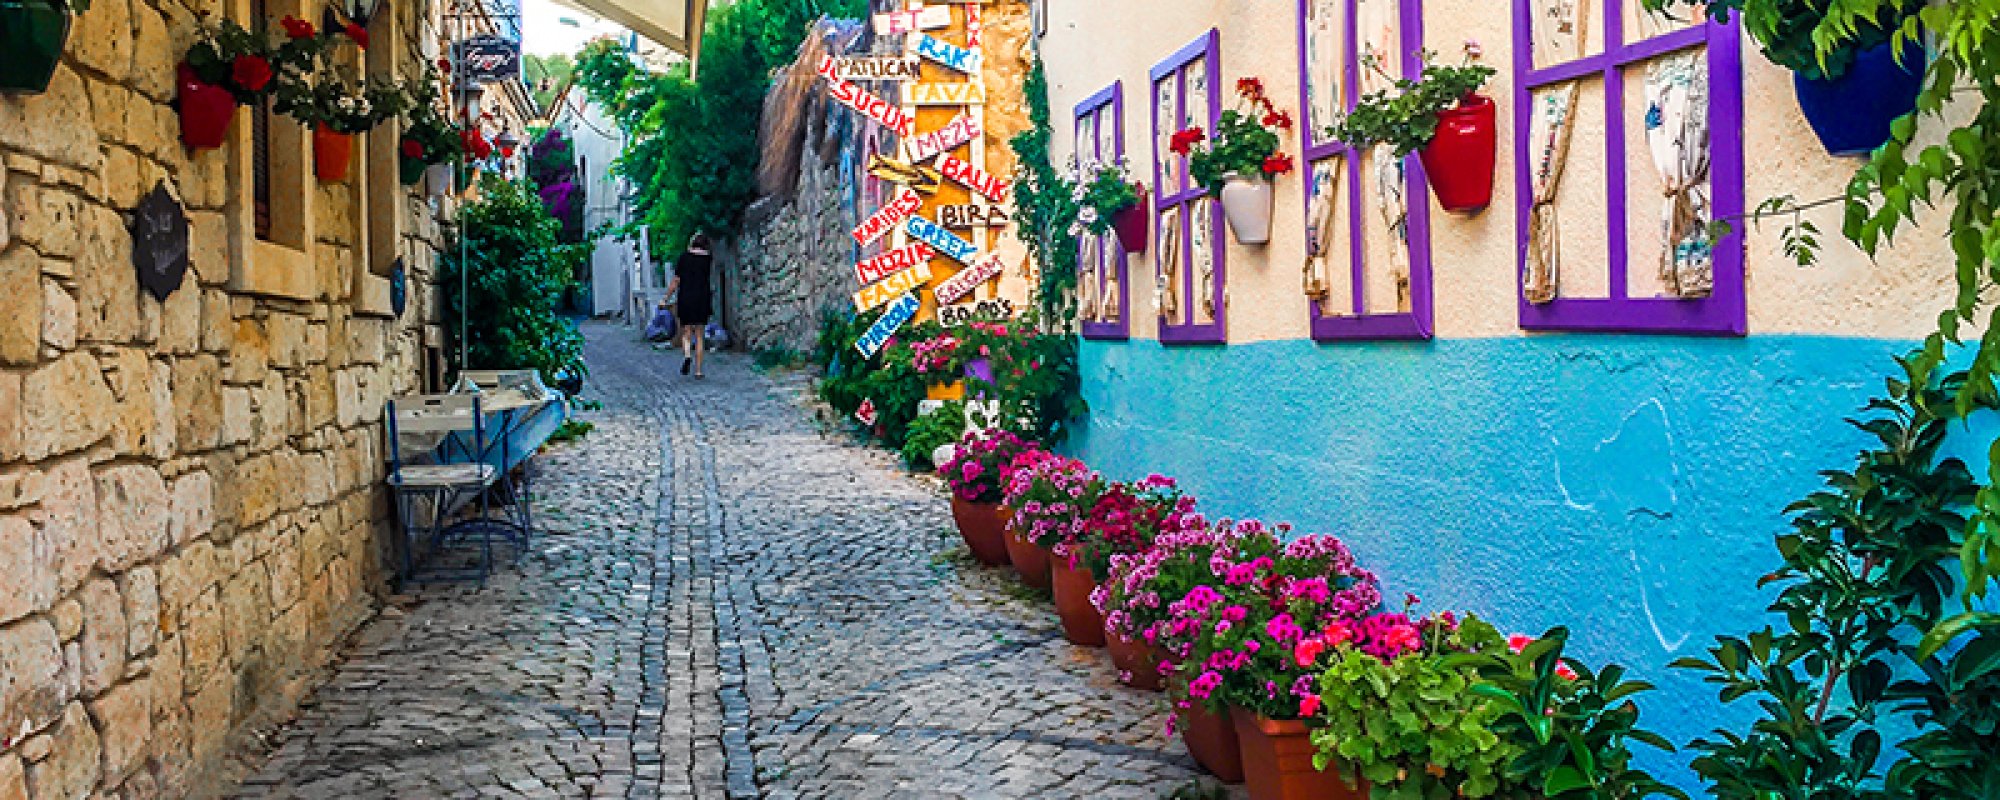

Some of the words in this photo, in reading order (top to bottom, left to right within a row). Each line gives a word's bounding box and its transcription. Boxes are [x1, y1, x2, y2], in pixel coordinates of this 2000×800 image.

[890, 9, 923, 34] ET
[837, 58, 920, 76] PATLICAN
[911, 83, 982, 101] FAVA
[832, 81, 913, 138] SUCUK
[917, 115, 980, 155] MEZE
[942, 156, 1007, 201] BALIK
[942, 204, 1008, 225] BIRA
